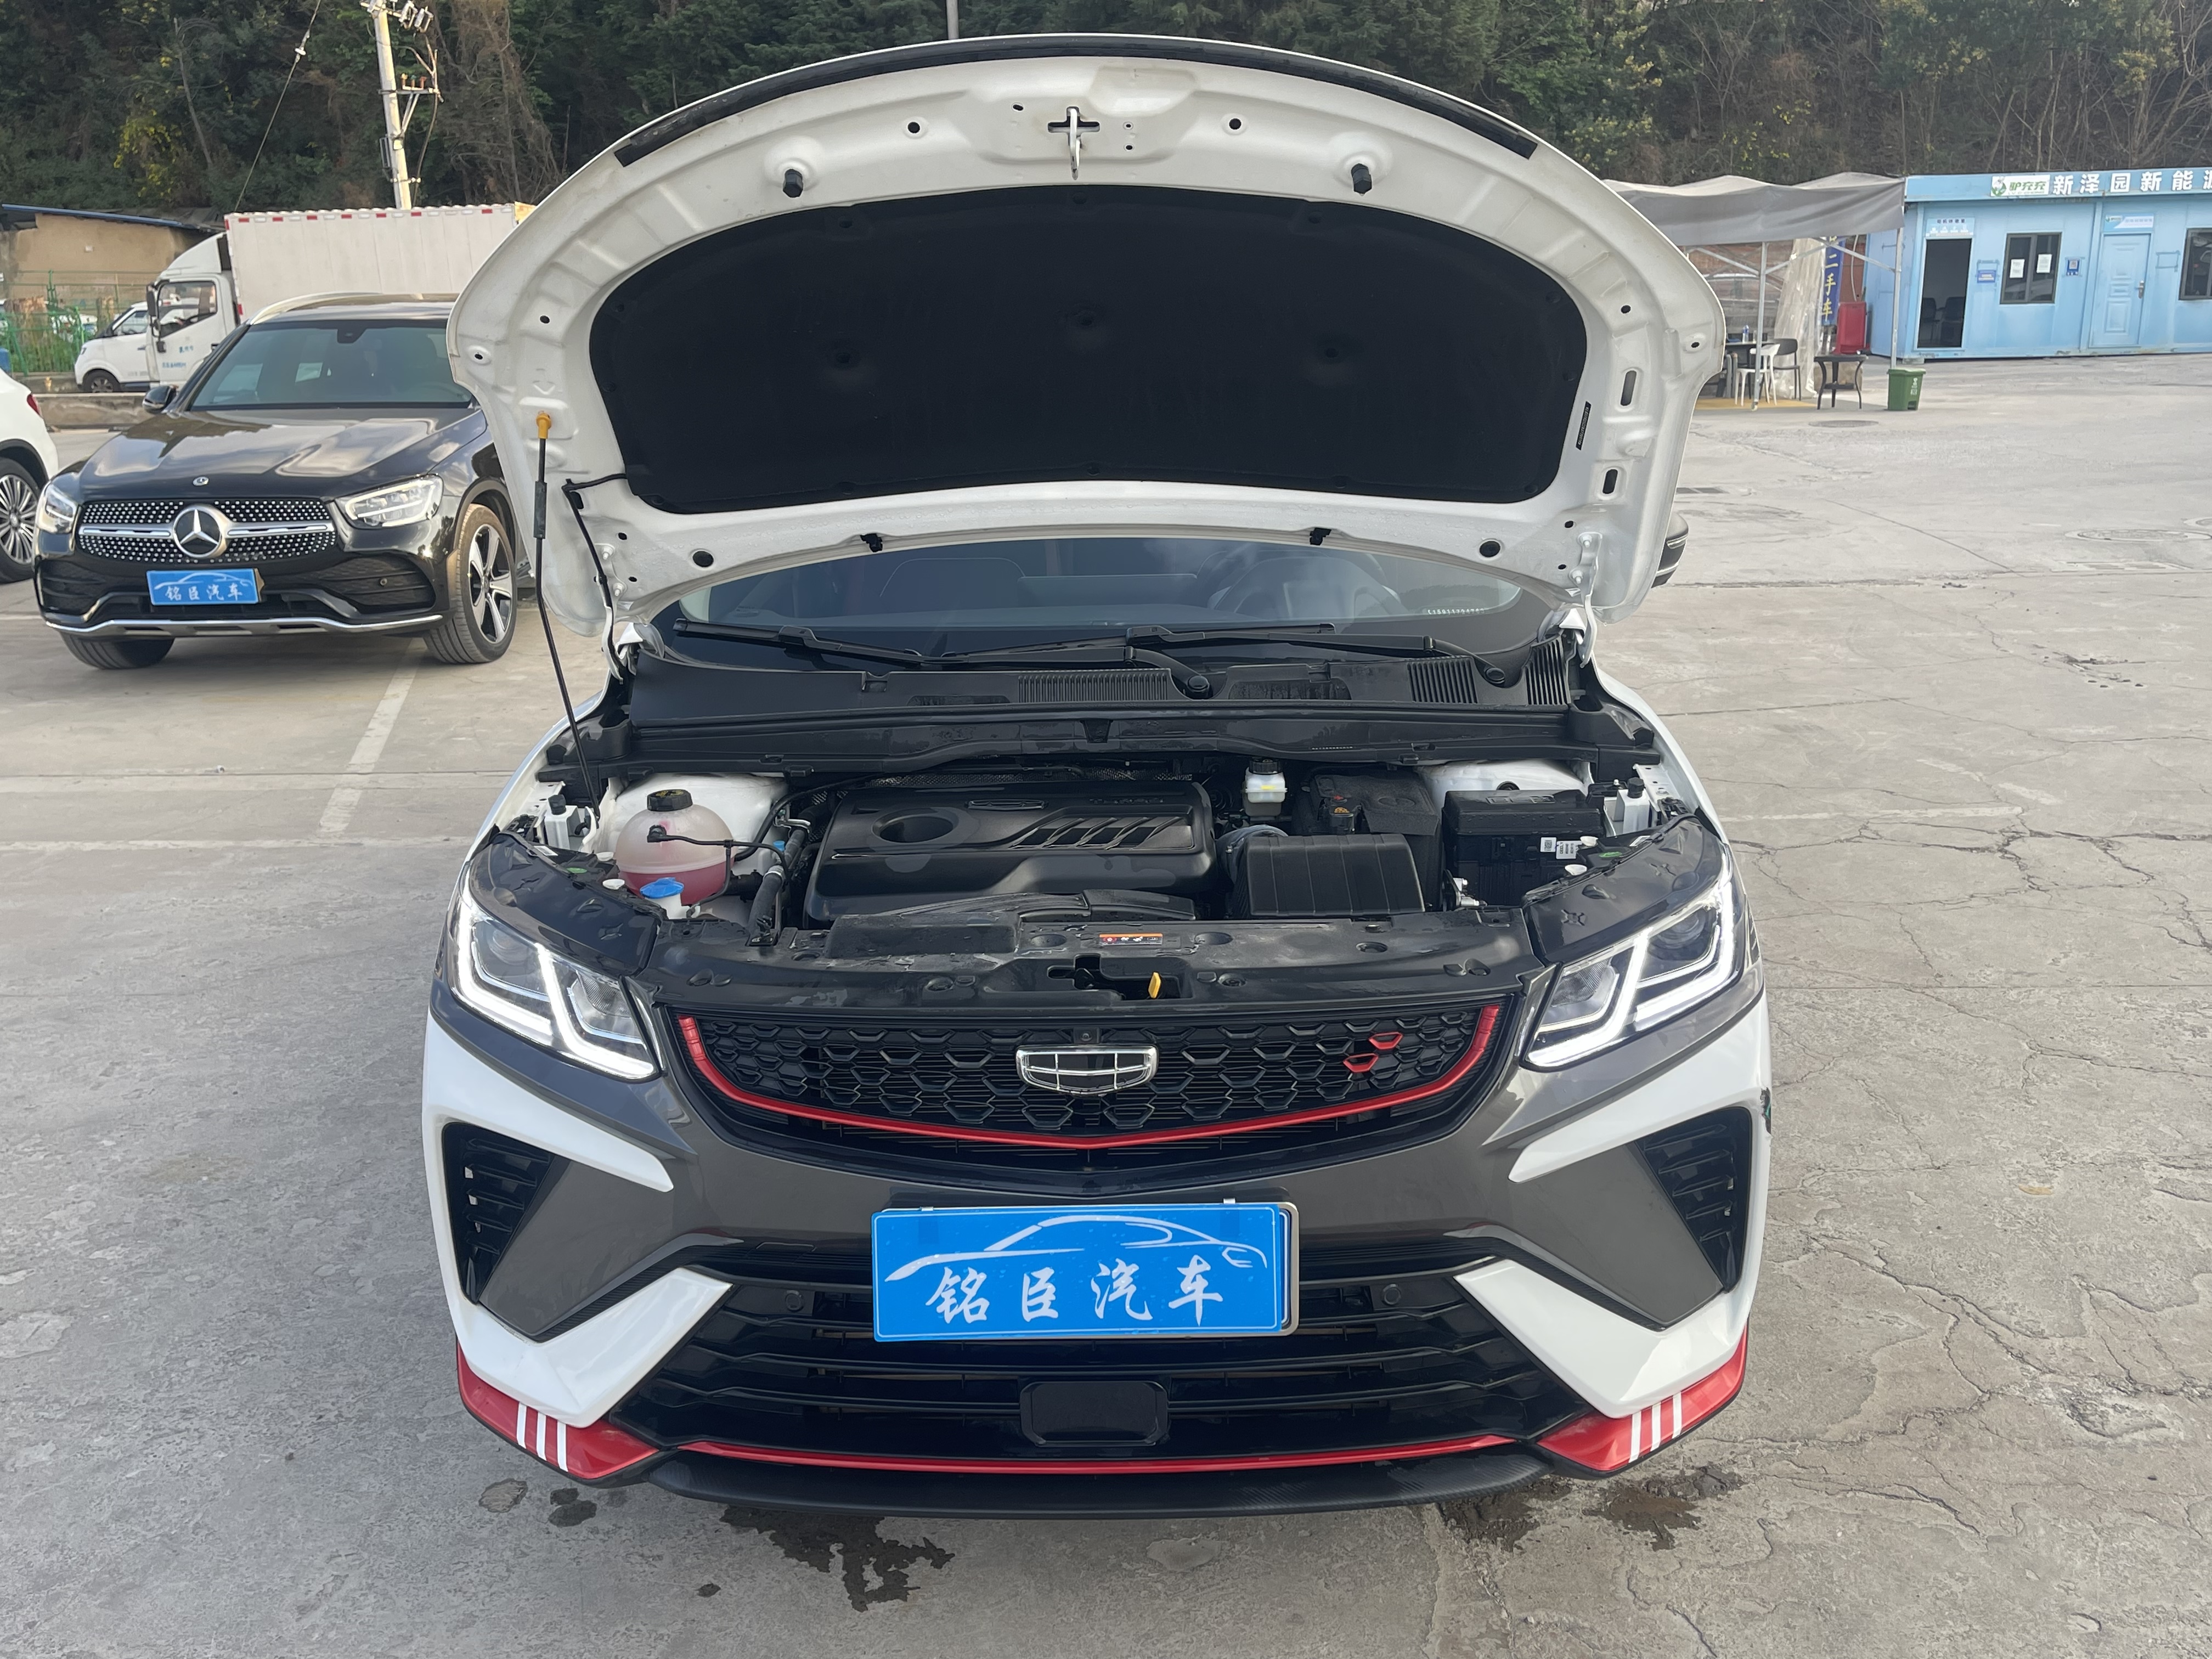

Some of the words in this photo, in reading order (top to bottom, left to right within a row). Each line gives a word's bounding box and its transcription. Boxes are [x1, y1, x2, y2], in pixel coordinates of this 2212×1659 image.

[165, 583, 242, 601] 铭臣汽车
[925, 1255, 1223, 1327] 铭臣汽车
